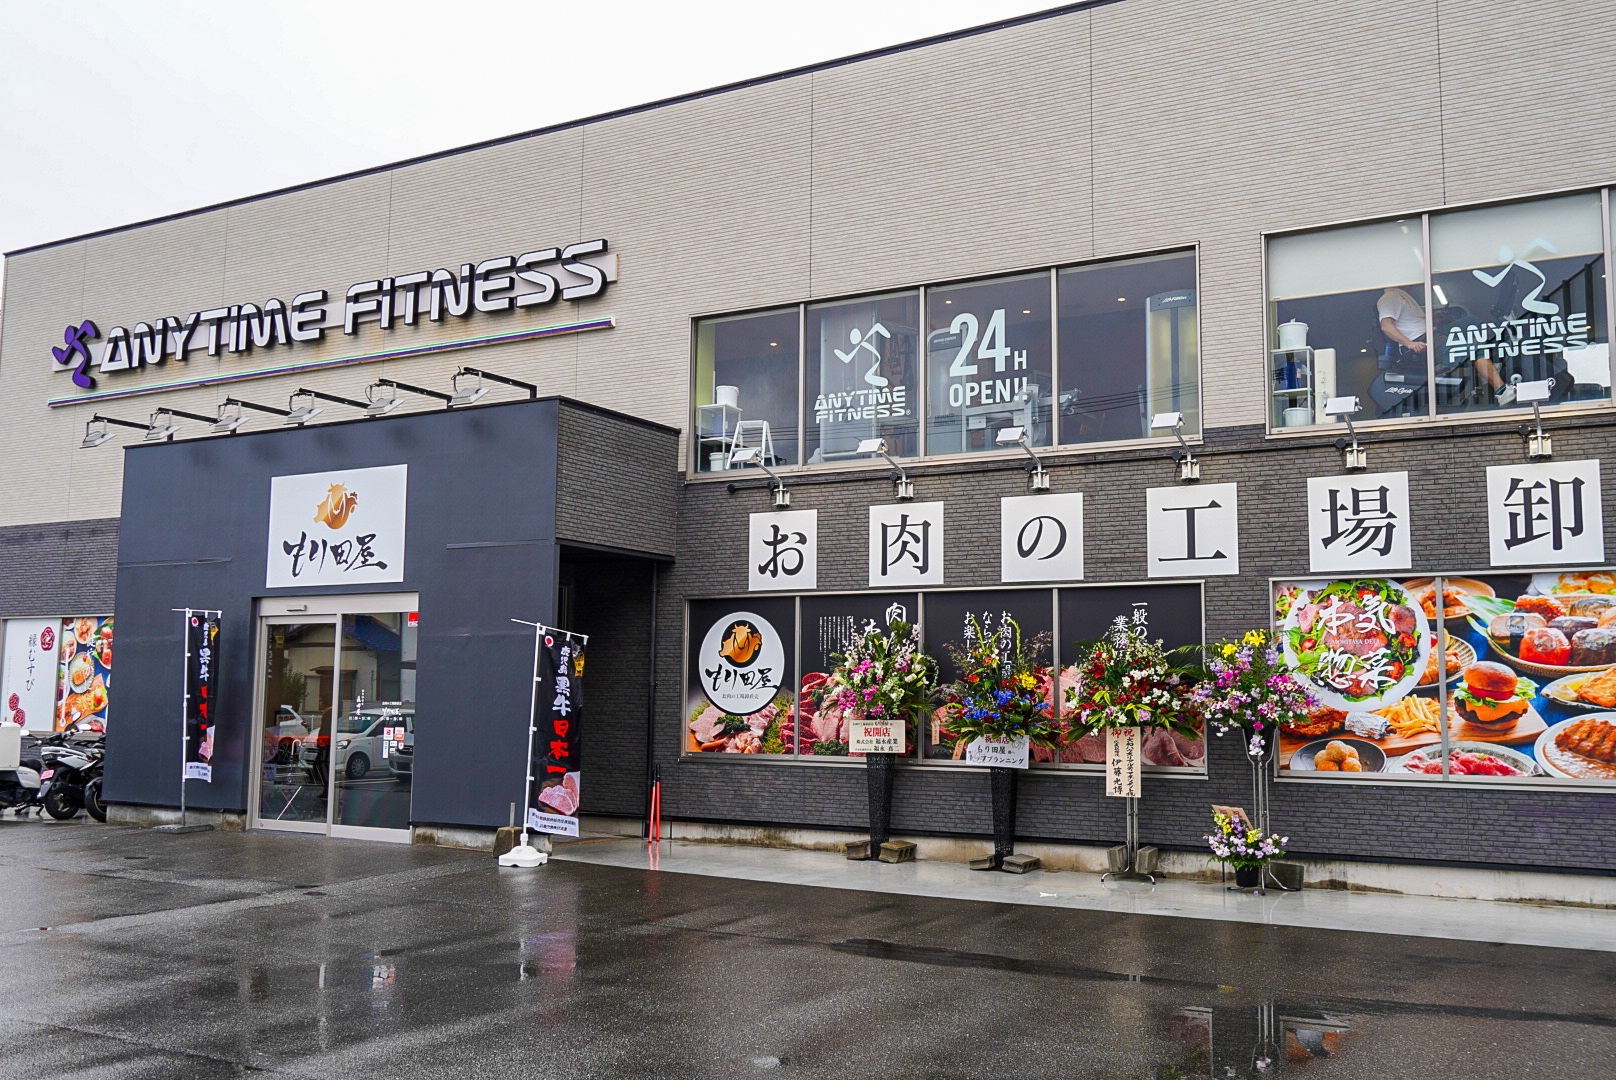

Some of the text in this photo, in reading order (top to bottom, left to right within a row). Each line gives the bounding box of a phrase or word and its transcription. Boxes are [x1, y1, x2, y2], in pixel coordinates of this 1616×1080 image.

[99, 238, 609, 373] ANYTIME FITNESS
[1445, 312, 1587, 347] ANYTIME
[1448, 334, 1588, 363] FITNESS
[814, 385, 906, 411] ANYTIME
[949, 376, 1028, 408] OPEN!!
[282, 530, 388, 578] もり田屋
[1316, 594, 1397, 636] 本気
[704, 663, 780, 692] もり田屋
[863, 726, 892, 737] 祝開店
[977, 744, 1006, 755] もり田屋
